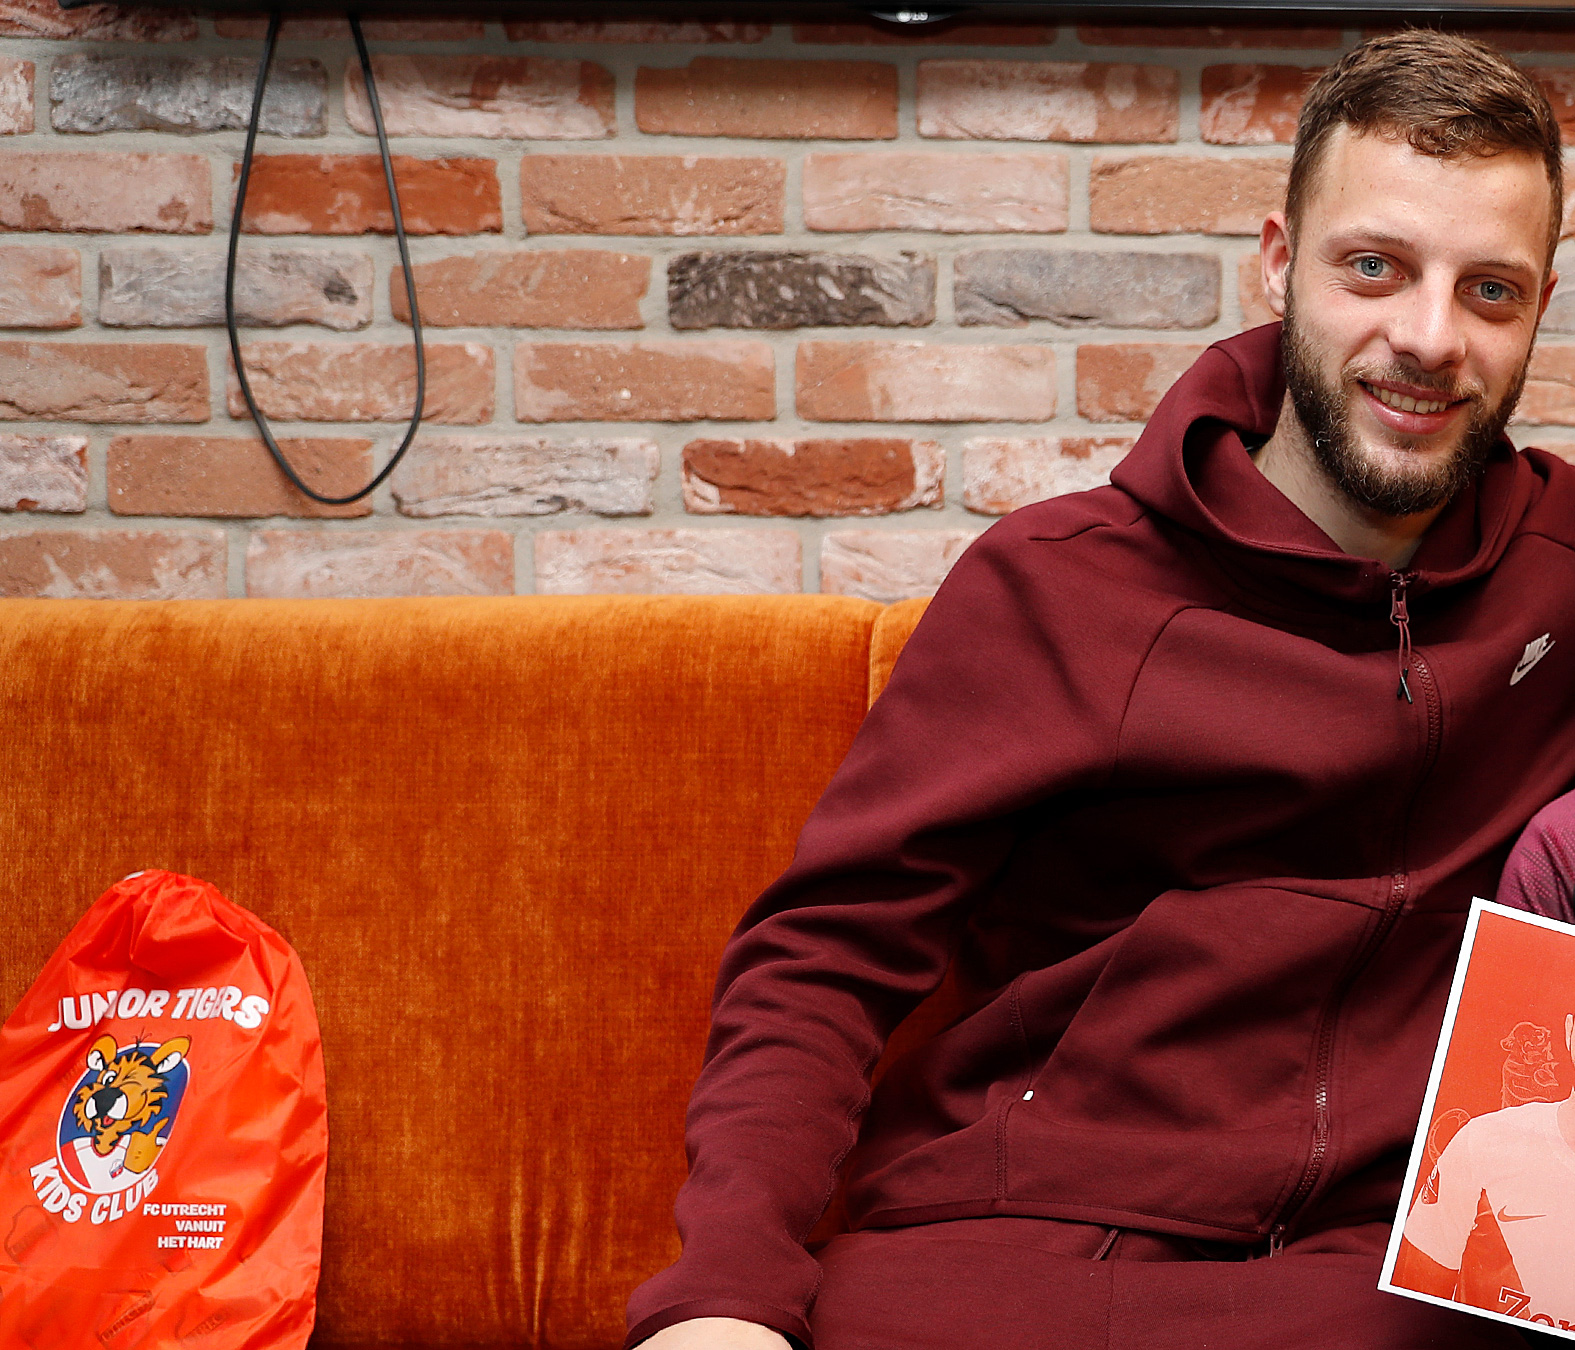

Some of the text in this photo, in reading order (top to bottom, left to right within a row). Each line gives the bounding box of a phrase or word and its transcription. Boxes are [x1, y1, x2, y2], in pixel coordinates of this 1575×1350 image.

[171, 985, 270, 1028] TIGERS
[29, 1157, 159, 1225] KIDS CLUB
[143, 1204, 227, 1216] FC UTRECHT
[175, 1220, 227, 1232] VANUIT
[157, 1236, 224, 1249] HET HART
